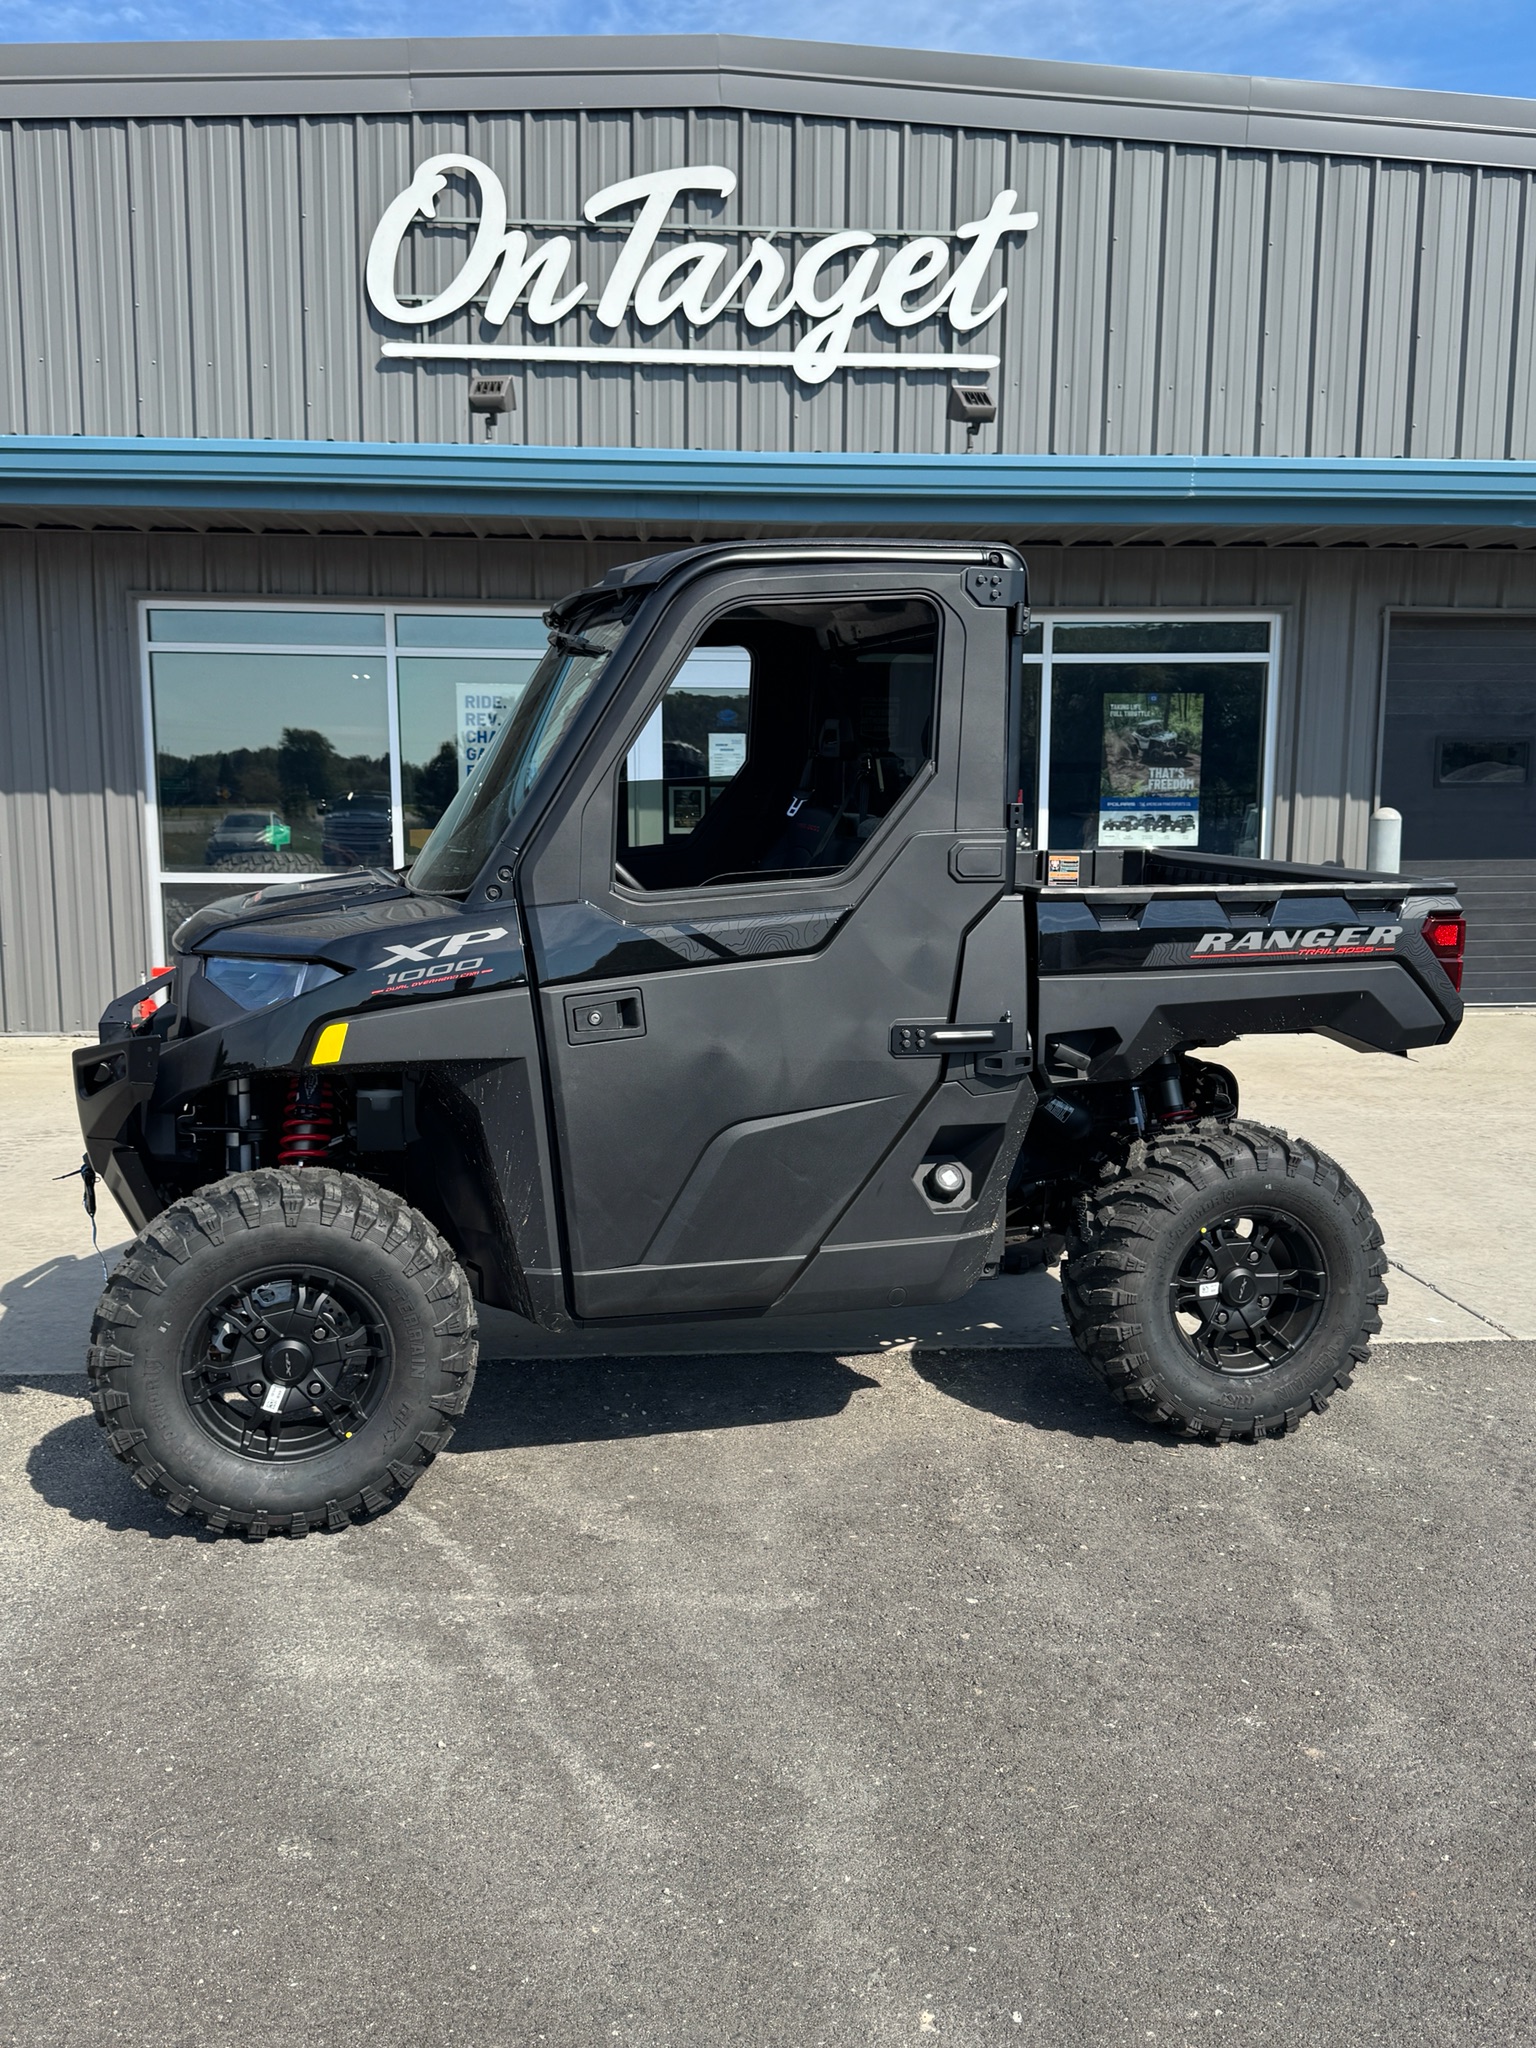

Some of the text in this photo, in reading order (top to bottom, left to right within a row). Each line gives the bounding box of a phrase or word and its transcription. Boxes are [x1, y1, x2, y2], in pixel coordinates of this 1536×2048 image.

[583, 165, 1039, 384] Target
[465, 695, 507, 709] RIDE.
[465, 712, 501, 726] REV.
[1149, 767, 1185, 779] THAT'S
[1149, 778, 1194, 790] FREEDOM
[367, 927, 509, 971] XP
[1194, 926, 1403, 952] RANGER
[1298, 946, 1375, 956] TRAIL BOSS
[387, 957, 484, 985] 1000
[370, 1267, 426, 1380] X-TERRAIN
